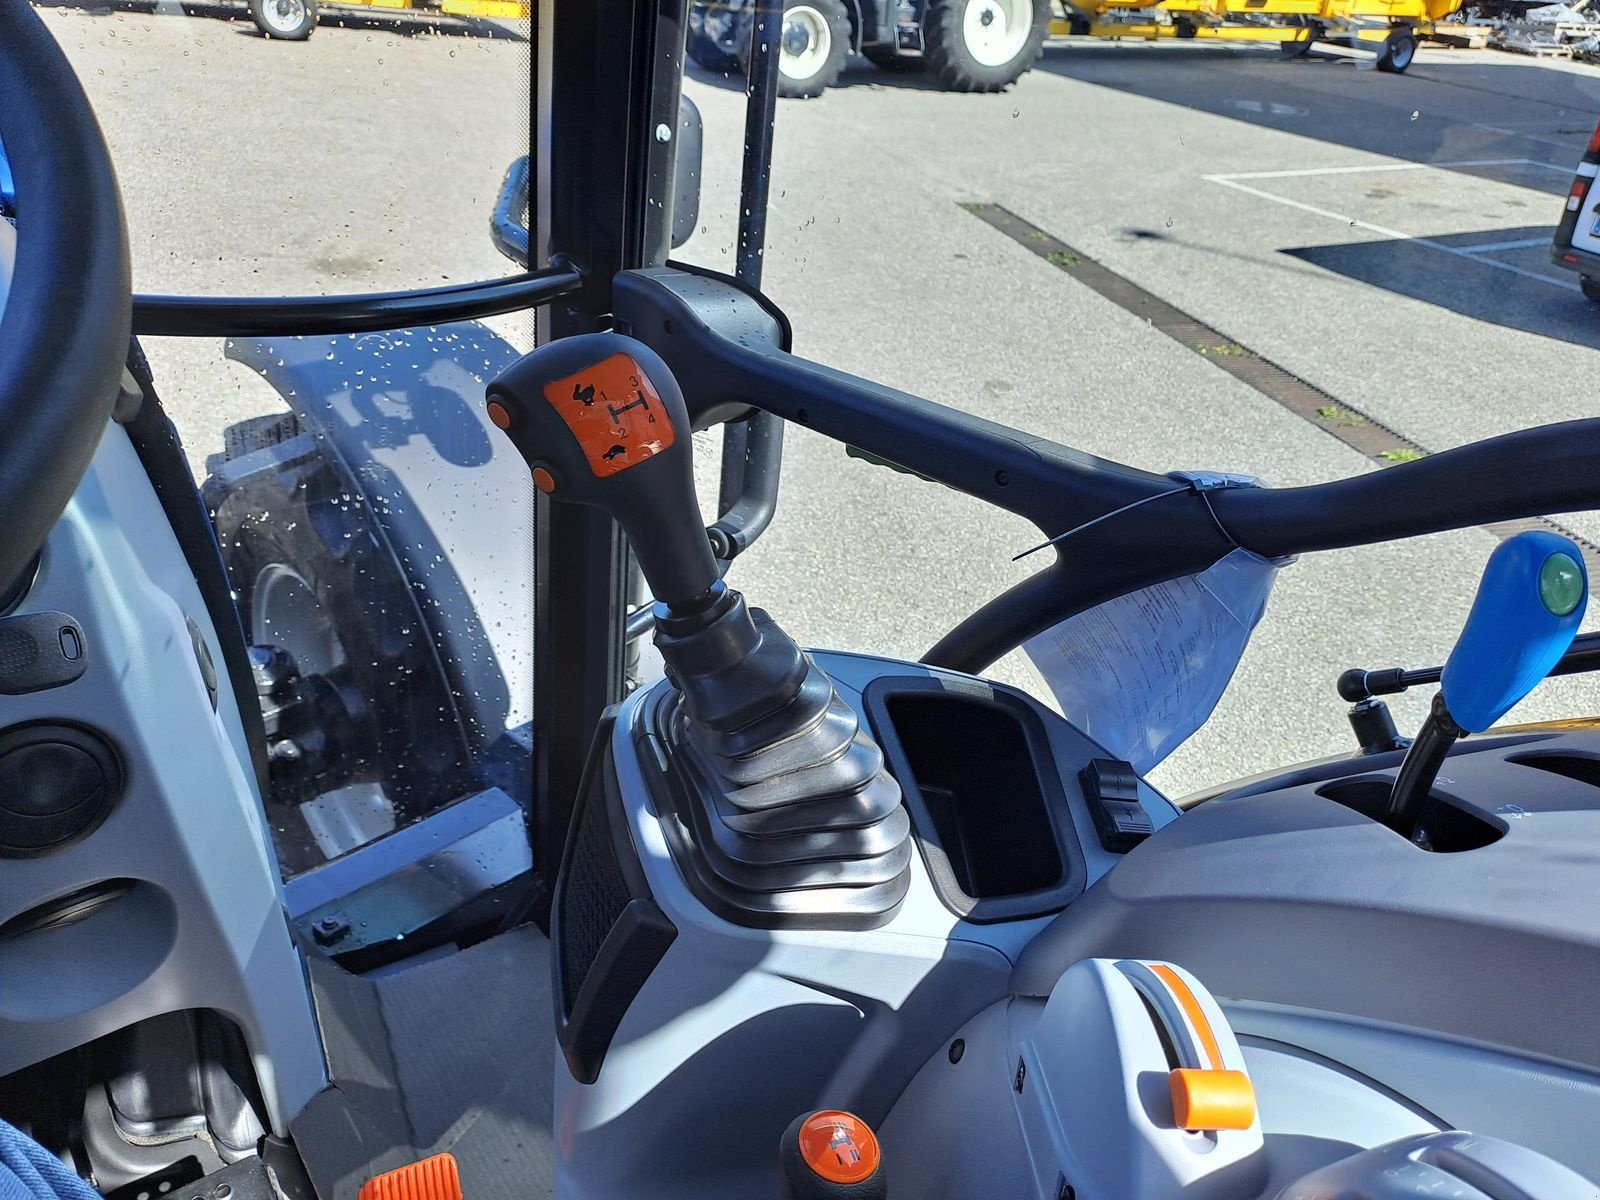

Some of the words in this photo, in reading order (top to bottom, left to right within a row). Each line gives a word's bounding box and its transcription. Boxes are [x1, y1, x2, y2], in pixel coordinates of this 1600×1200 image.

[629, 376, 639, 387] 3
[600, 390, 608, 401] 1
[648, 413, 656, 424] 4
[619, 427, 628, 439] 2
